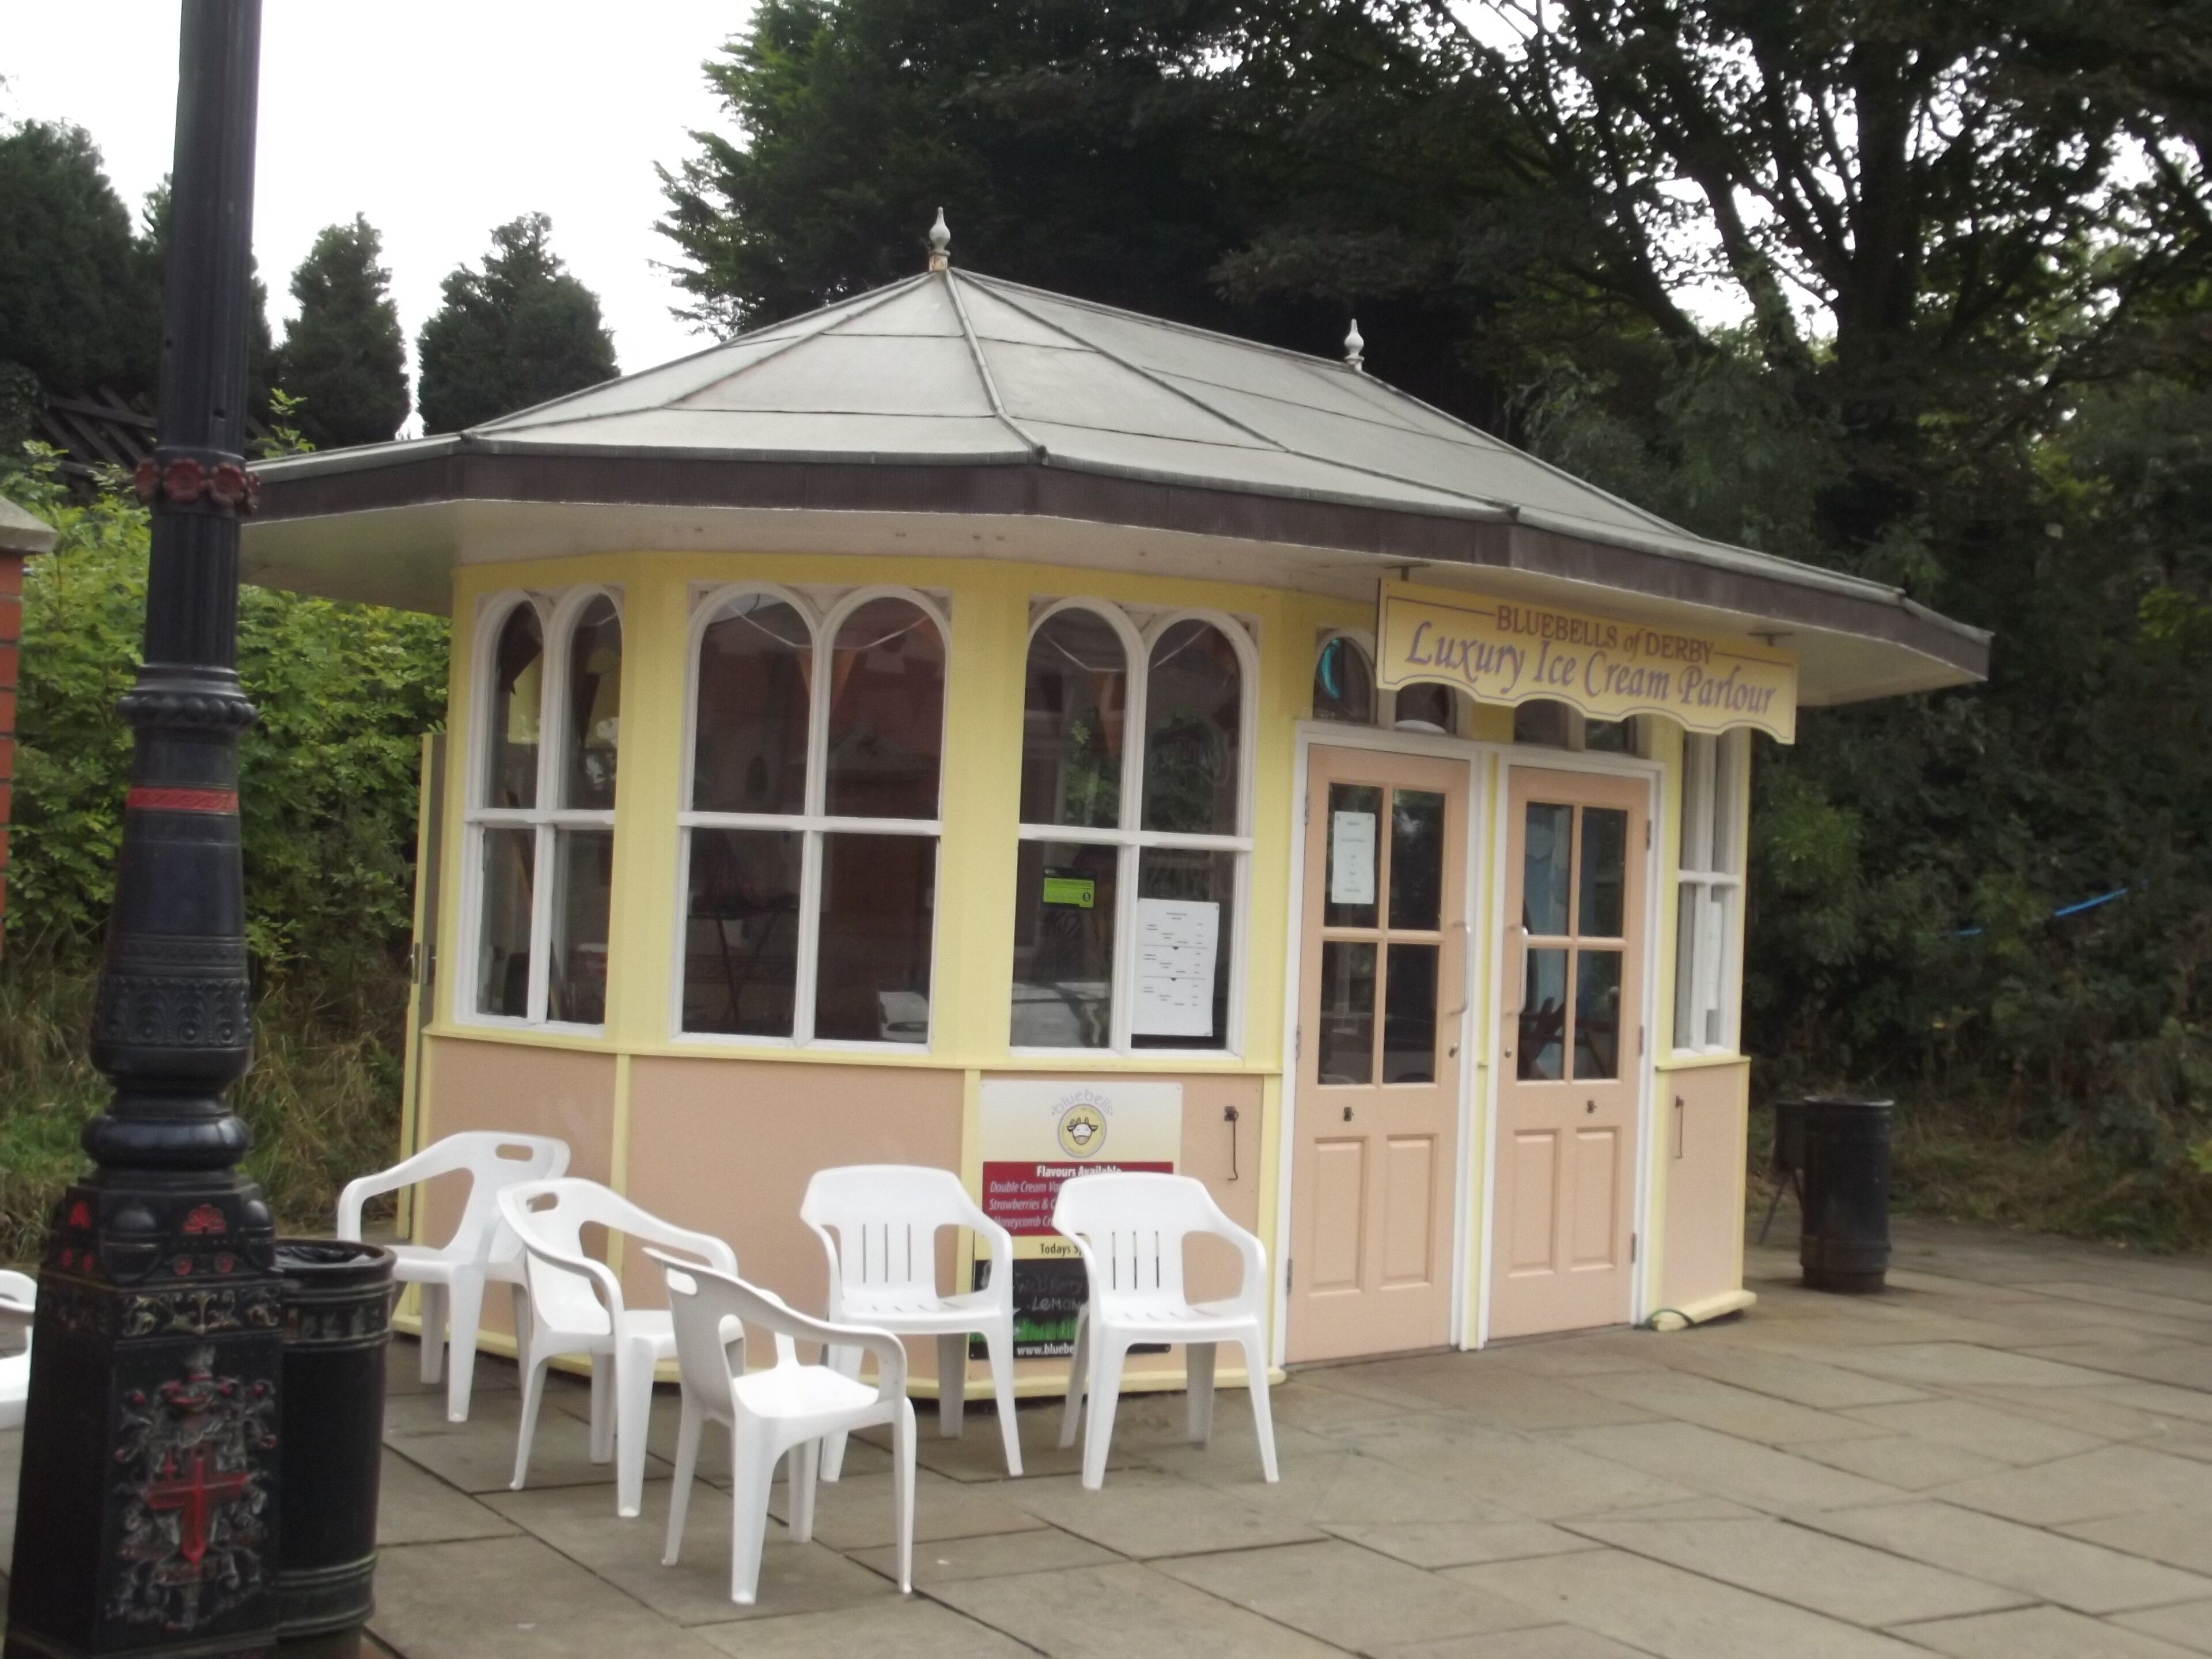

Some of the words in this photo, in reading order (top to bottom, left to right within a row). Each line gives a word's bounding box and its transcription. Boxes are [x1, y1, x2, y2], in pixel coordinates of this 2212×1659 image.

[1497, 605, 1618, 650] BLUEBELLS
[1623, 628, 1646, 662] of
[1646, 631, 1715, 665] DERBY
[1404, 620, 1525, 695] Luxury
[1532, 639, 1577, 687] Ice
[1584, 650, 1671, 702] Cream
[1677, 665, 1777, 715] Parlour
[1051, 1088, 1113, 1115] bluebells
[1037, 1165, 1076, 1177] Flavours
[990, 1181, 1018, 1192] Double
[1020, 1181, 1047, 1192] Cream
[989, 1198, 1039, 1210] Strawberries
[1041, 1198, 1048, 1210] &
[994, 1215, 1041, 1230] Honeycomb
[1040, 1243, 1071, 1256] Todays
[1017, 1342, 1075, 1355] www.bluebe
